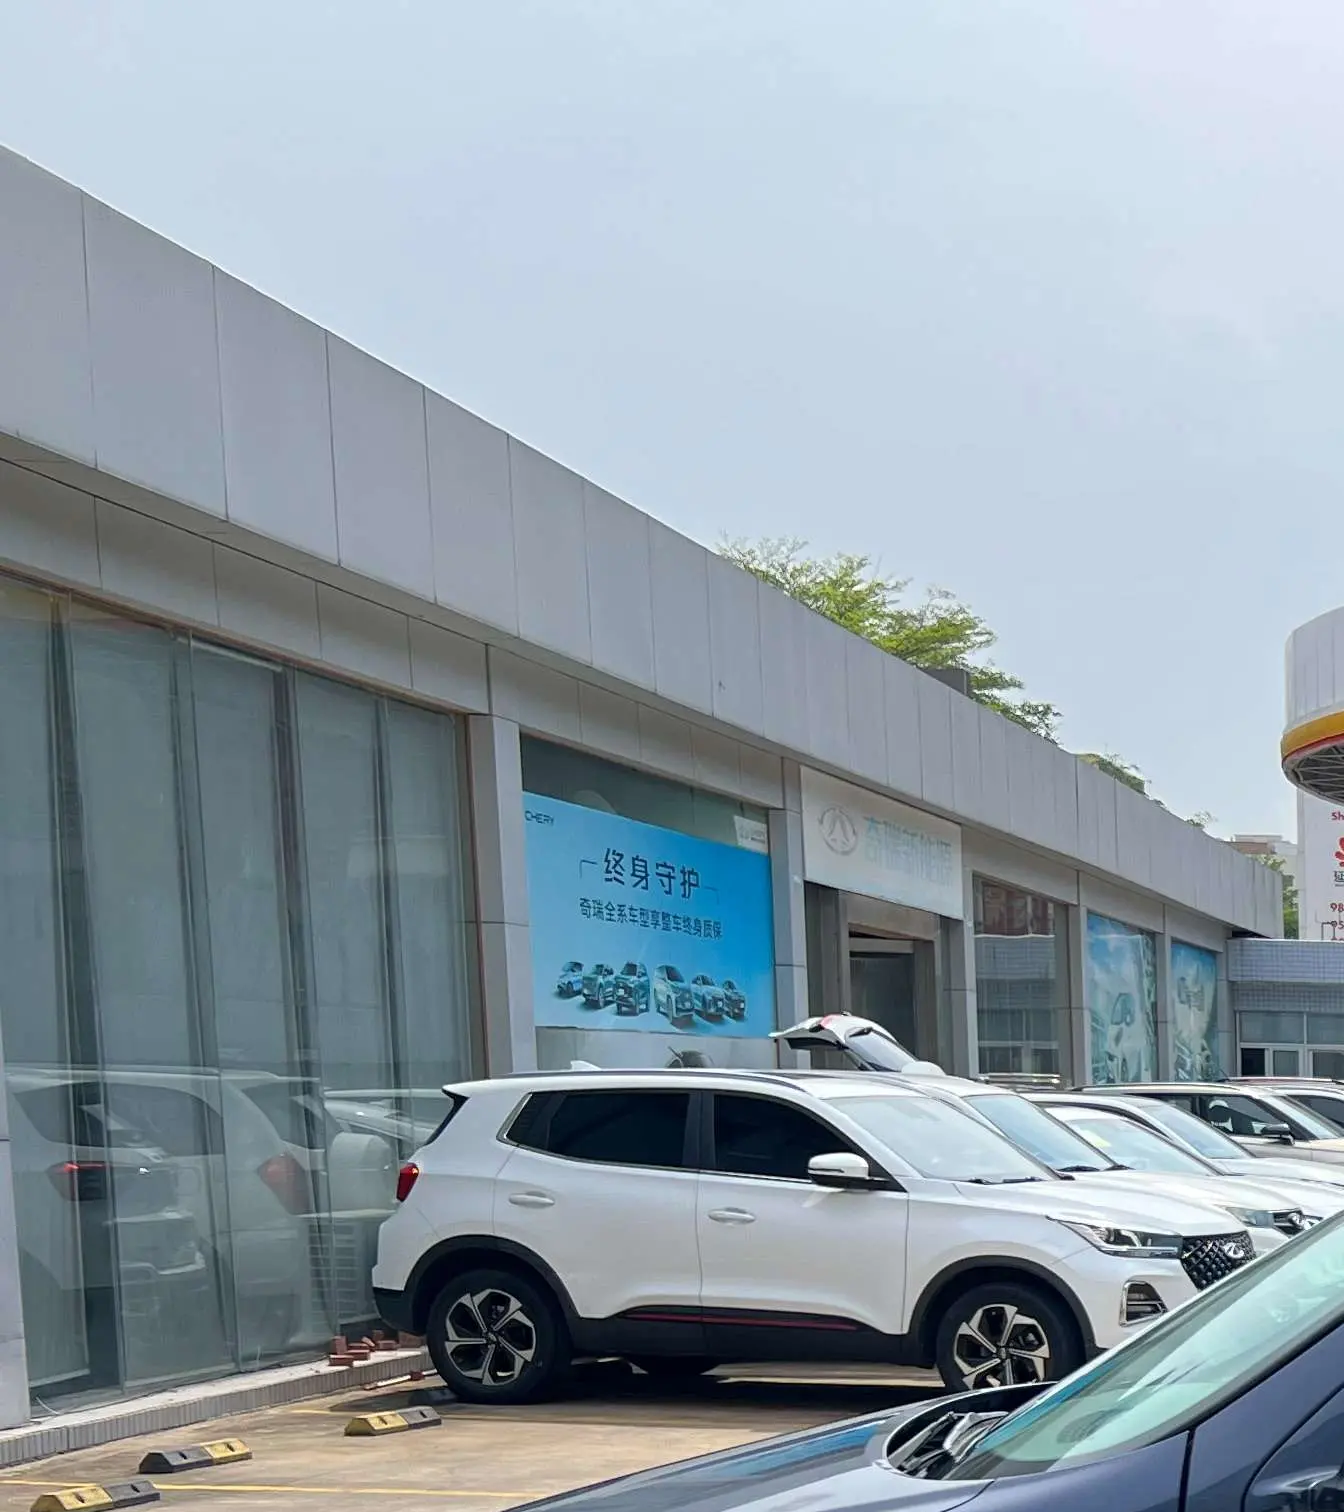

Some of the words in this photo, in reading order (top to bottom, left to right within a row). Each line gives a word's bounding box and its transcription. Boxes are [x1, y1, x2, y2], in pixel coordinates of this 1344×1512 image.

[525, 810, 555, 826] CHERY
[604, 848, 700, 899] 终身守护
[579, 897, 723, 940] 奇瑞全系车型享整车终身质保
